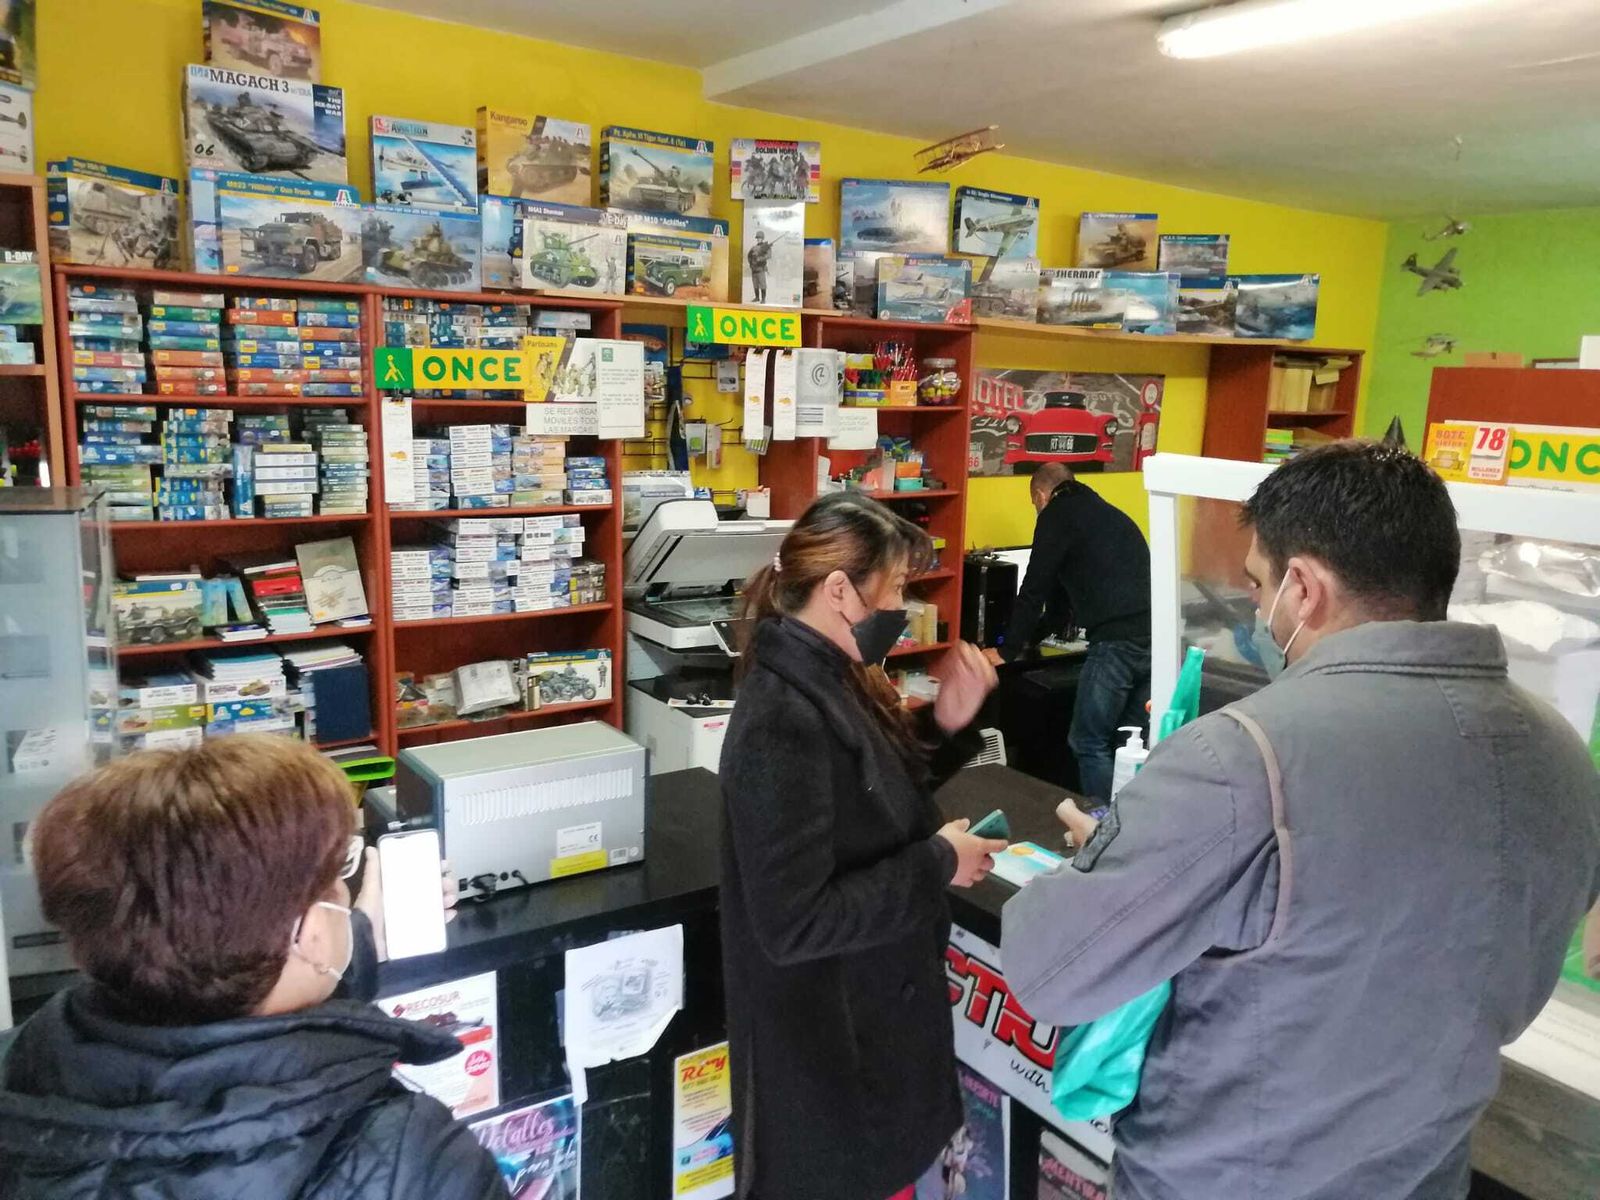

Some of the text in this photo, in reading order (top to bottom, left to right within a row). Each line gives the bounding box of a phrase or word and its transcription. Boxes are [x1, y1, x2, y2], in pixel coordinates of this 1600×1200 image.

[209, 69, 280, 92] MAGACH
[282, 81, 290, 93] 3
[490, 111, 528, 127] Kangaroo
[194, 144, 215, 156] 06
[644, 216, 658, 225] M10
[720, 315, 795, 340] ONCE
[422, 356, 522, 382] ONCE
[544, 407, 556, 415] SE
[1476, 427, 1506, 451] 78
[1509, 439, 1600, 475] ONC
[406, 991, 461, 1012] RECOSUR
[1010, 1058, 1050, 1094] with
